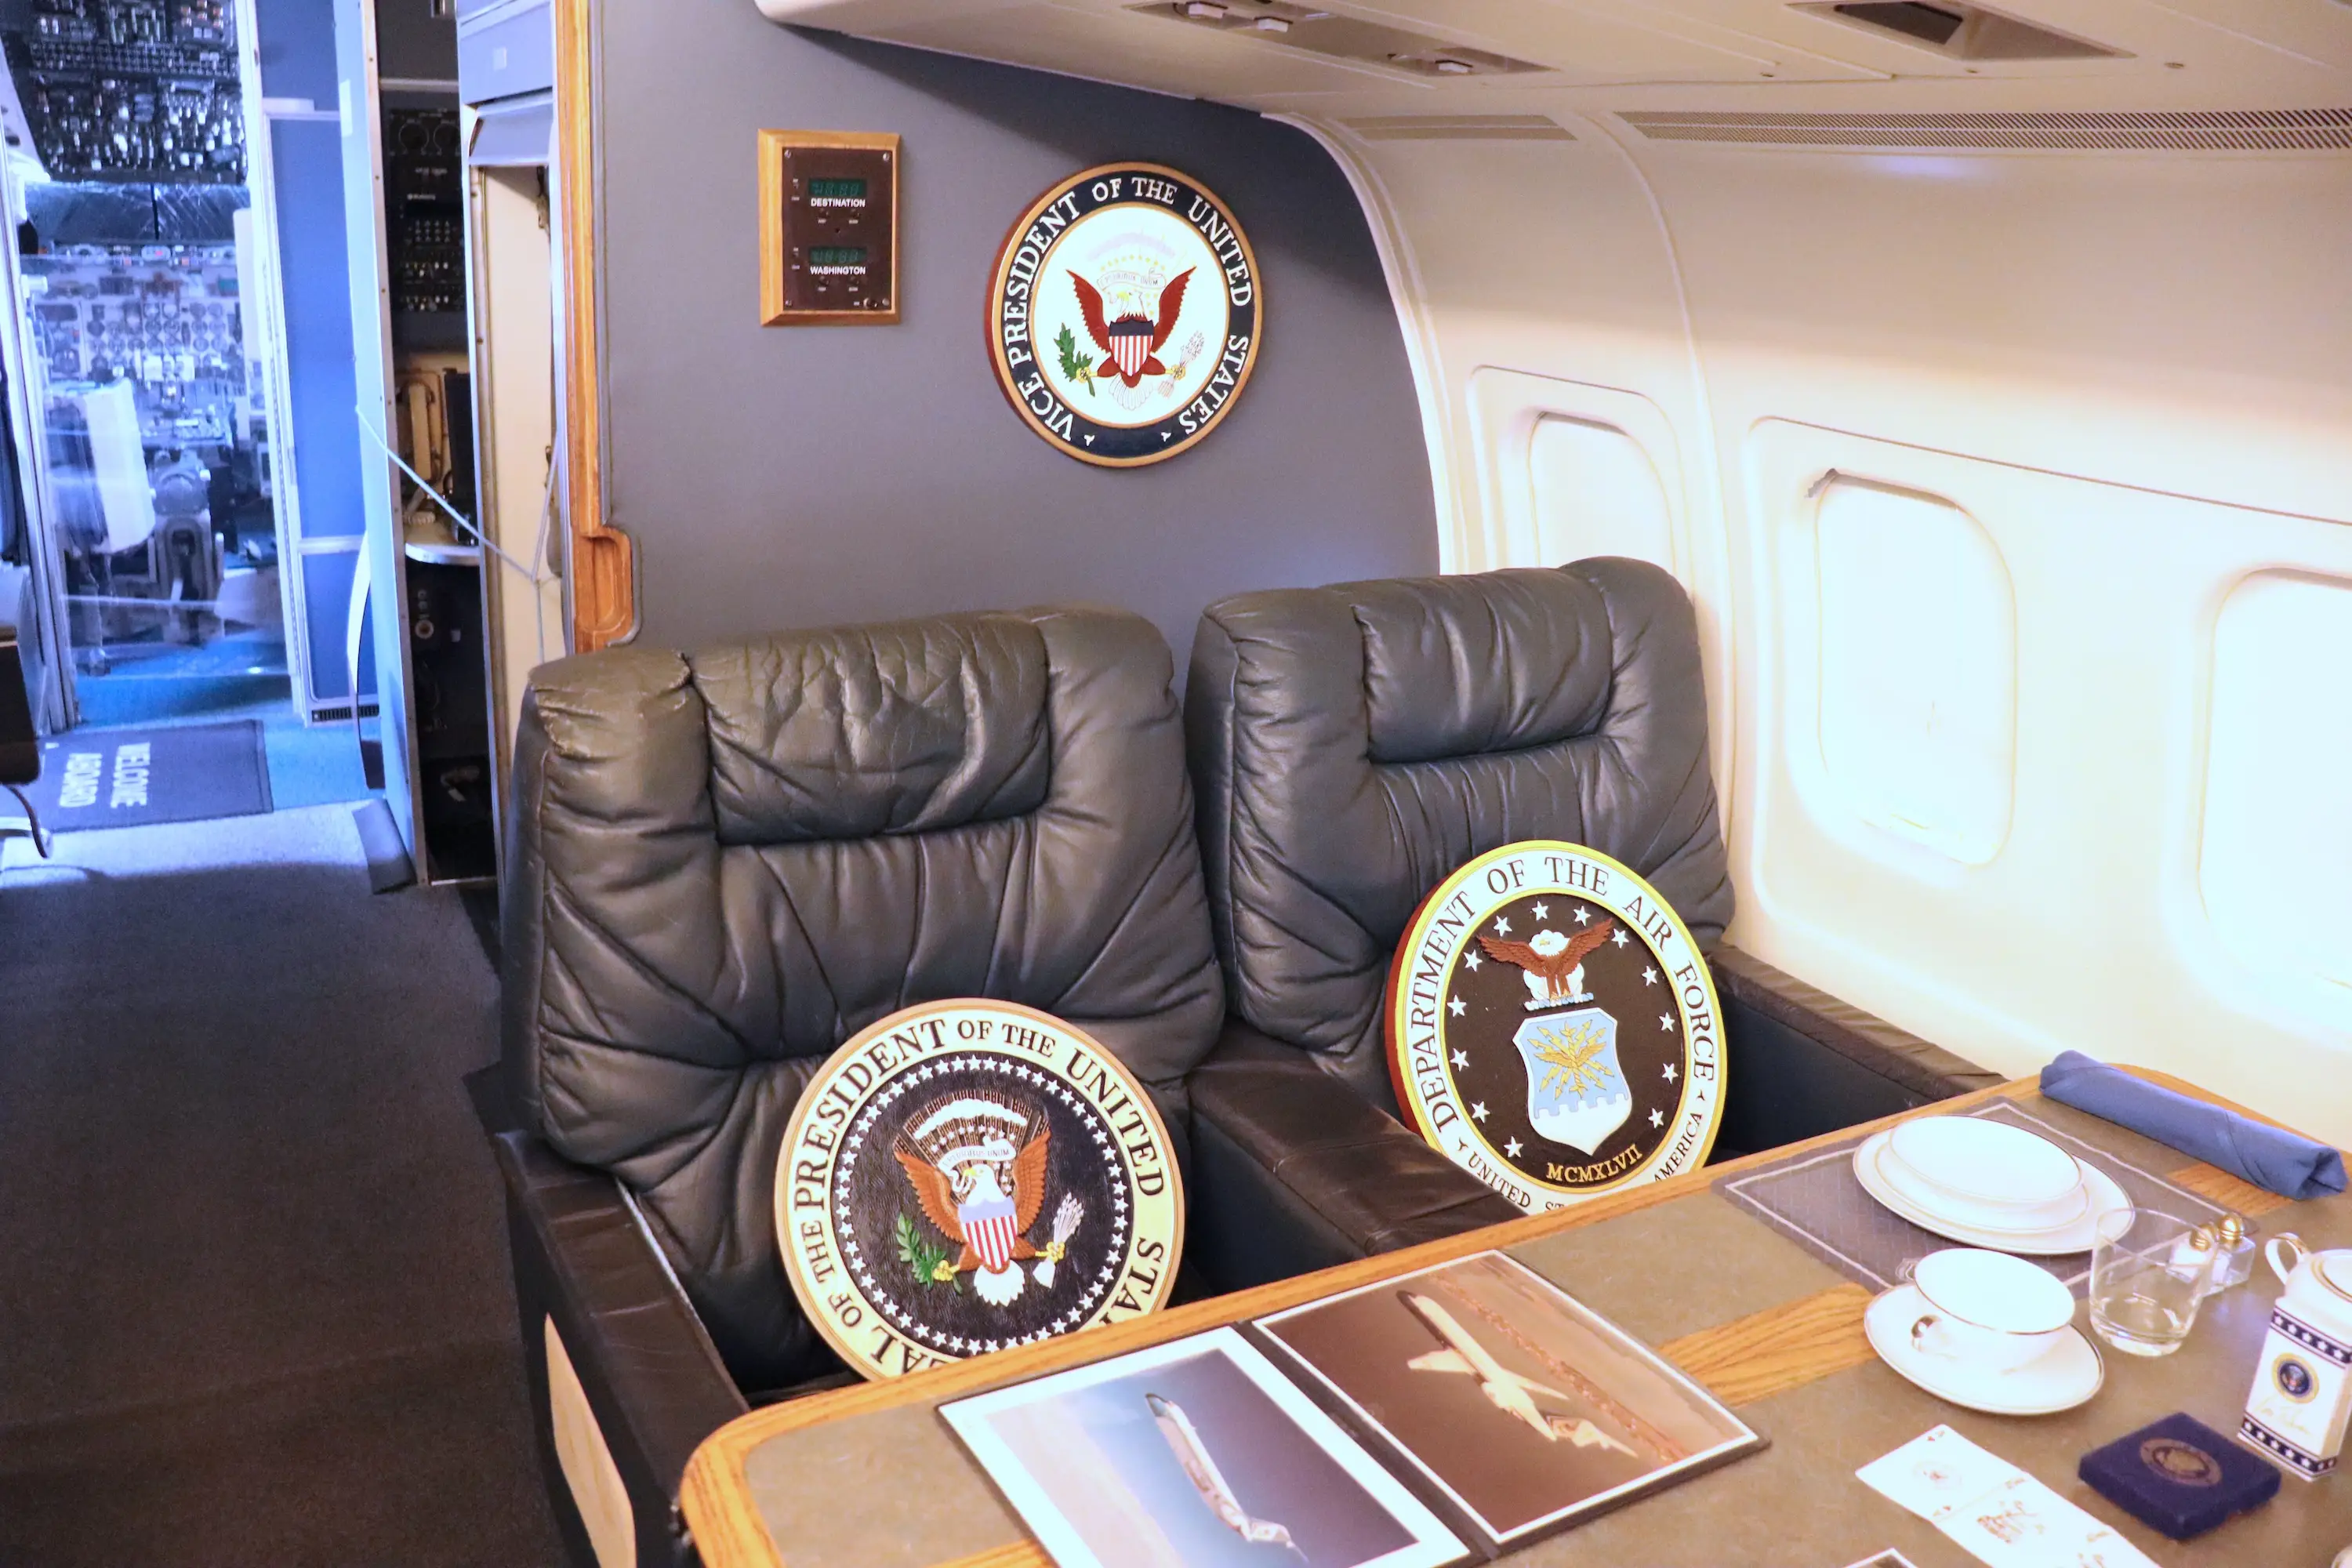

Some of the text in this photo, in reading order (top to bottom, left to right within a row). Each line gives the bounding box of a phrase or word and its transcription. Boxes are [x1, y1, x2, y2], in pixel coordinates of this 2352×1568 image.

[810, 198, 866, 208] DESTINATION
[810, 265, 866, 275] WASHINGTON
[1004, 177, 1253, 443] VICE PRESIDENT OF THE UNITED STATES
[1410, 856, 1715, 1134] DEPARTMENT OF THE AIR FORCE
[956, 1019, 993, 1041] OF
[1001, 1024, 1058, 1058] THE
[795, 1019, 946, 1211] PRESIDENT
[1065, 1047, 1165, 1197] UNITED
[1468, 1152, 1531, 1208] UNITED
[1546, 1144, 1643, 1182] MCMXLVII
[800, 1220, 838, 1283] THE
[1099, 1236, 1164, 1325] STA
[828, 1294, 862, 1328] OF
